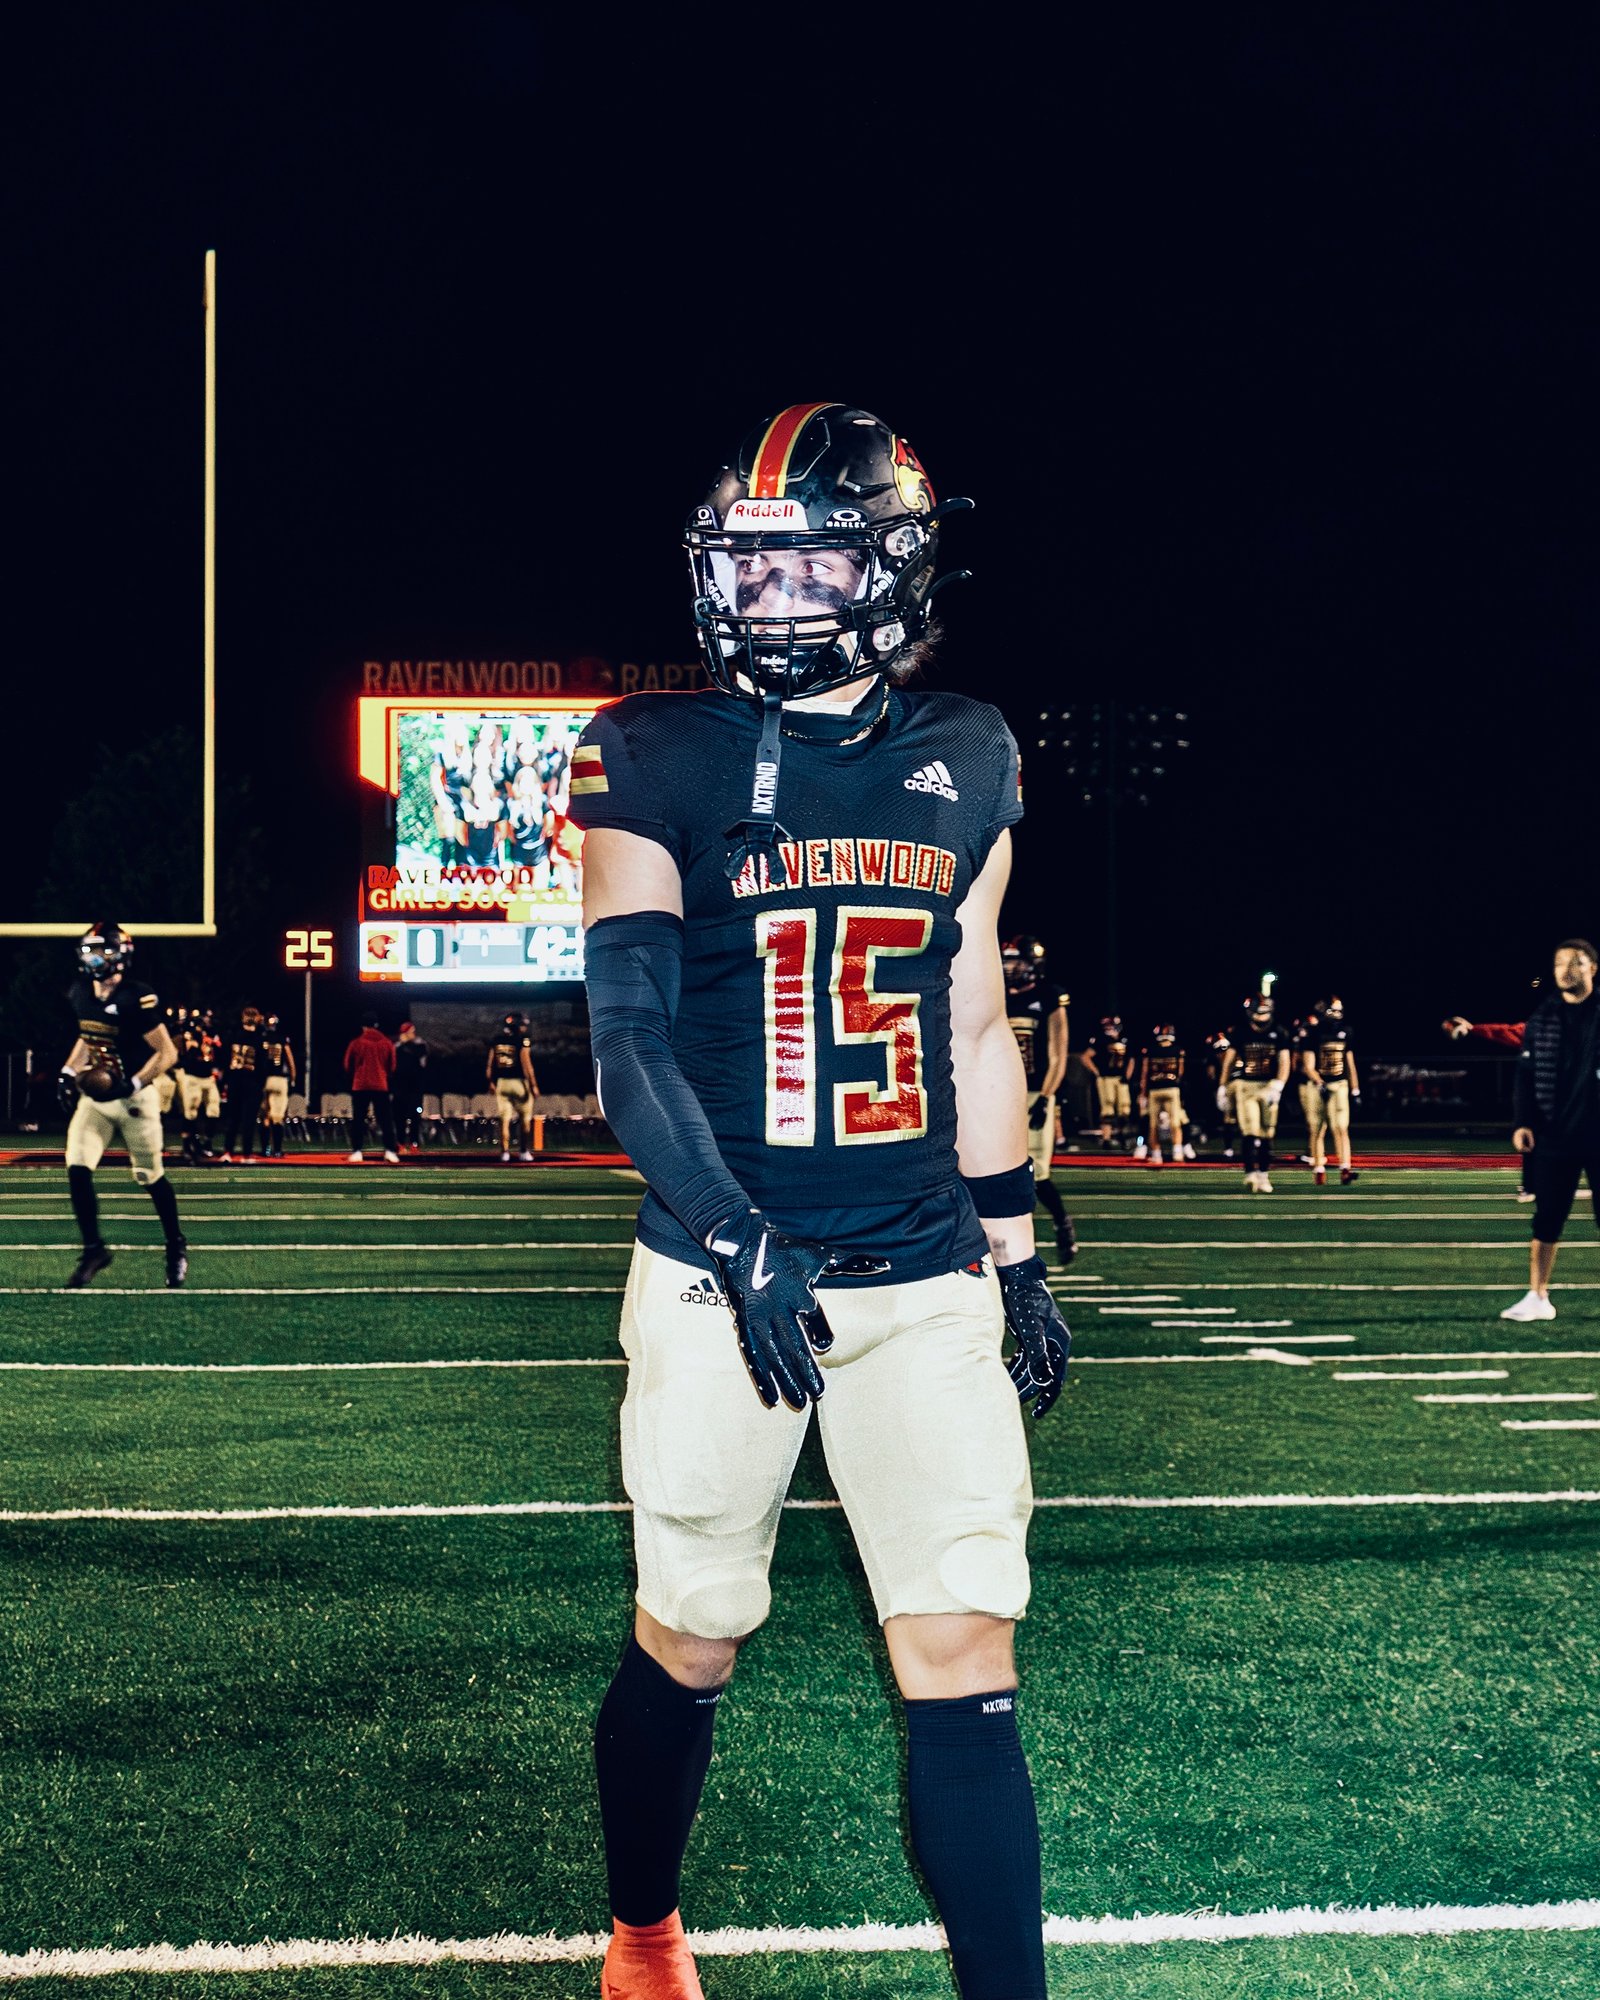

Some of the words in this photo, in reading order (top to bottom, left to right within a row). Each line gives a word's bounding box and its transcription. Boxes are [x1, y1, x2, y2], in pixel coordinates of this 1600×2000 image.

[735, 504, 793, 518] Riddell
[826, 520, 867, 528] OAKLEY
[760, 655, 789, 666] Riddel
[363, 661, 562, 693] RAVENWOOD
[620, 663, 714, 692] RAPT
[752, 762, 777, 814] NXTRND
[904, 778, 958, 802] adidas
[370, 866, 534, 887] RAVENWOOD
[370, 888, 453, 910] GIRLS
[286, 931, 333, 967] 25
[755, 906, 934, 1147] 15
[680, 1291, 729, 1307] adida
